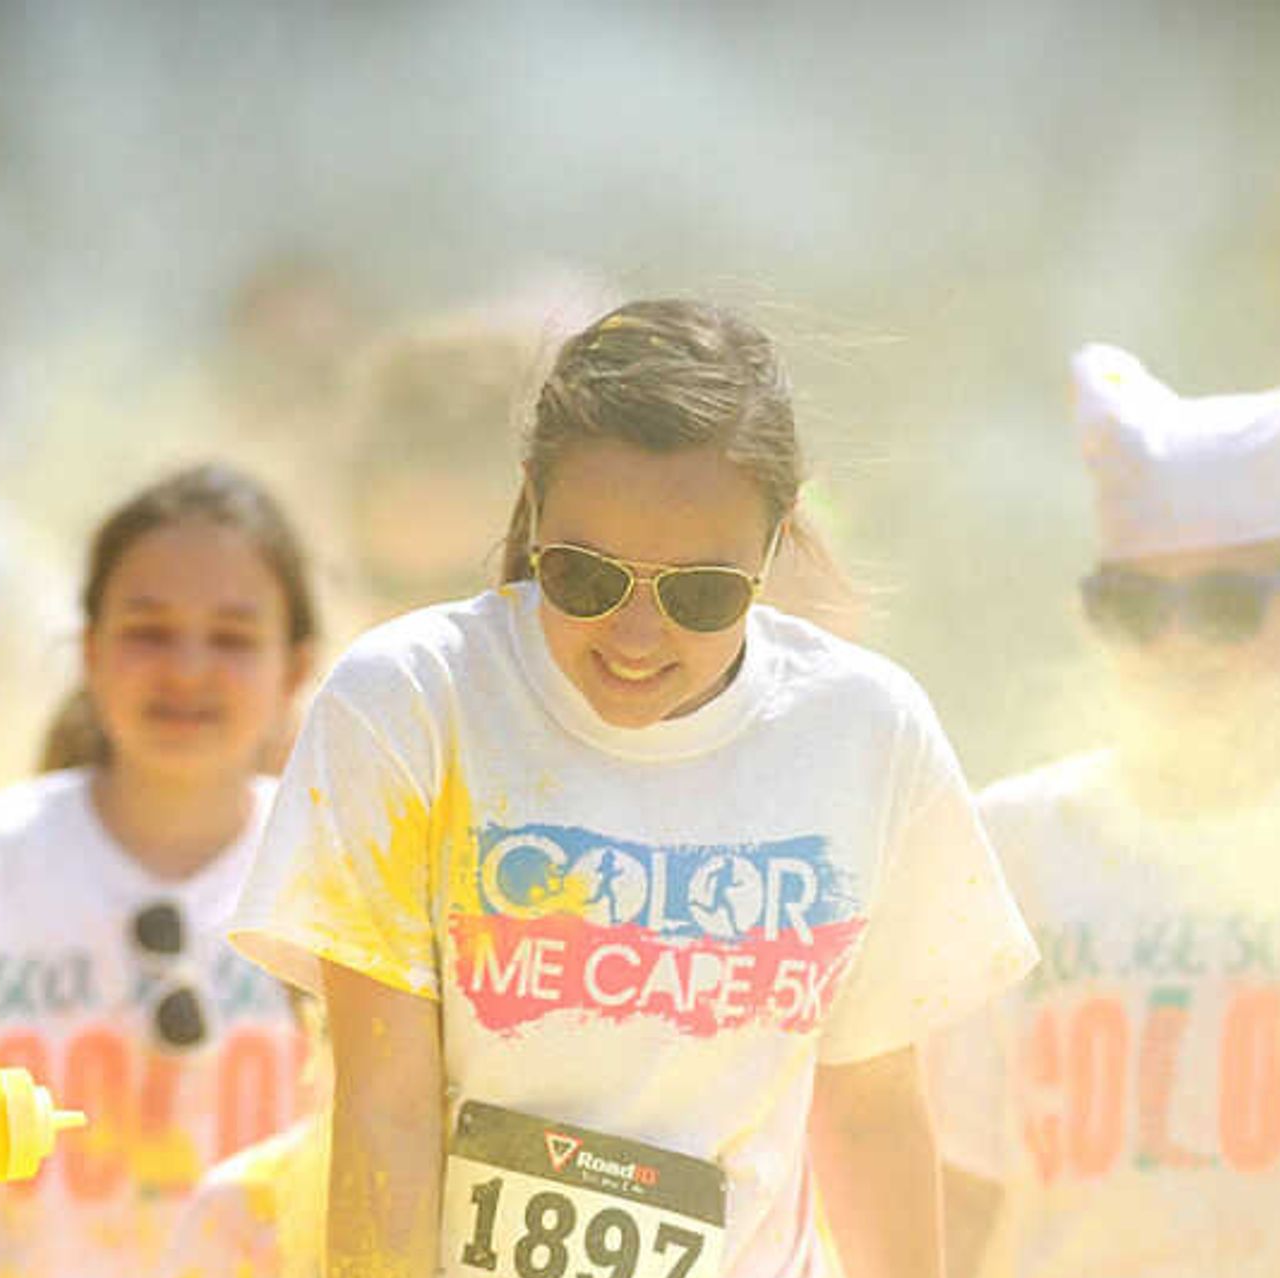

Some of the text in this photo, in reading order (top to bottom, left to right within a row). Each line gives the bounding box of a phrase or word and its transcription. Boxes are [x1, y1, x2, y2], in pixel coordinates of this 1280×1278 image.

[481, 834, 819, 946] COLOR
[471, 929, 846, 1024] ME CAPE 5K
